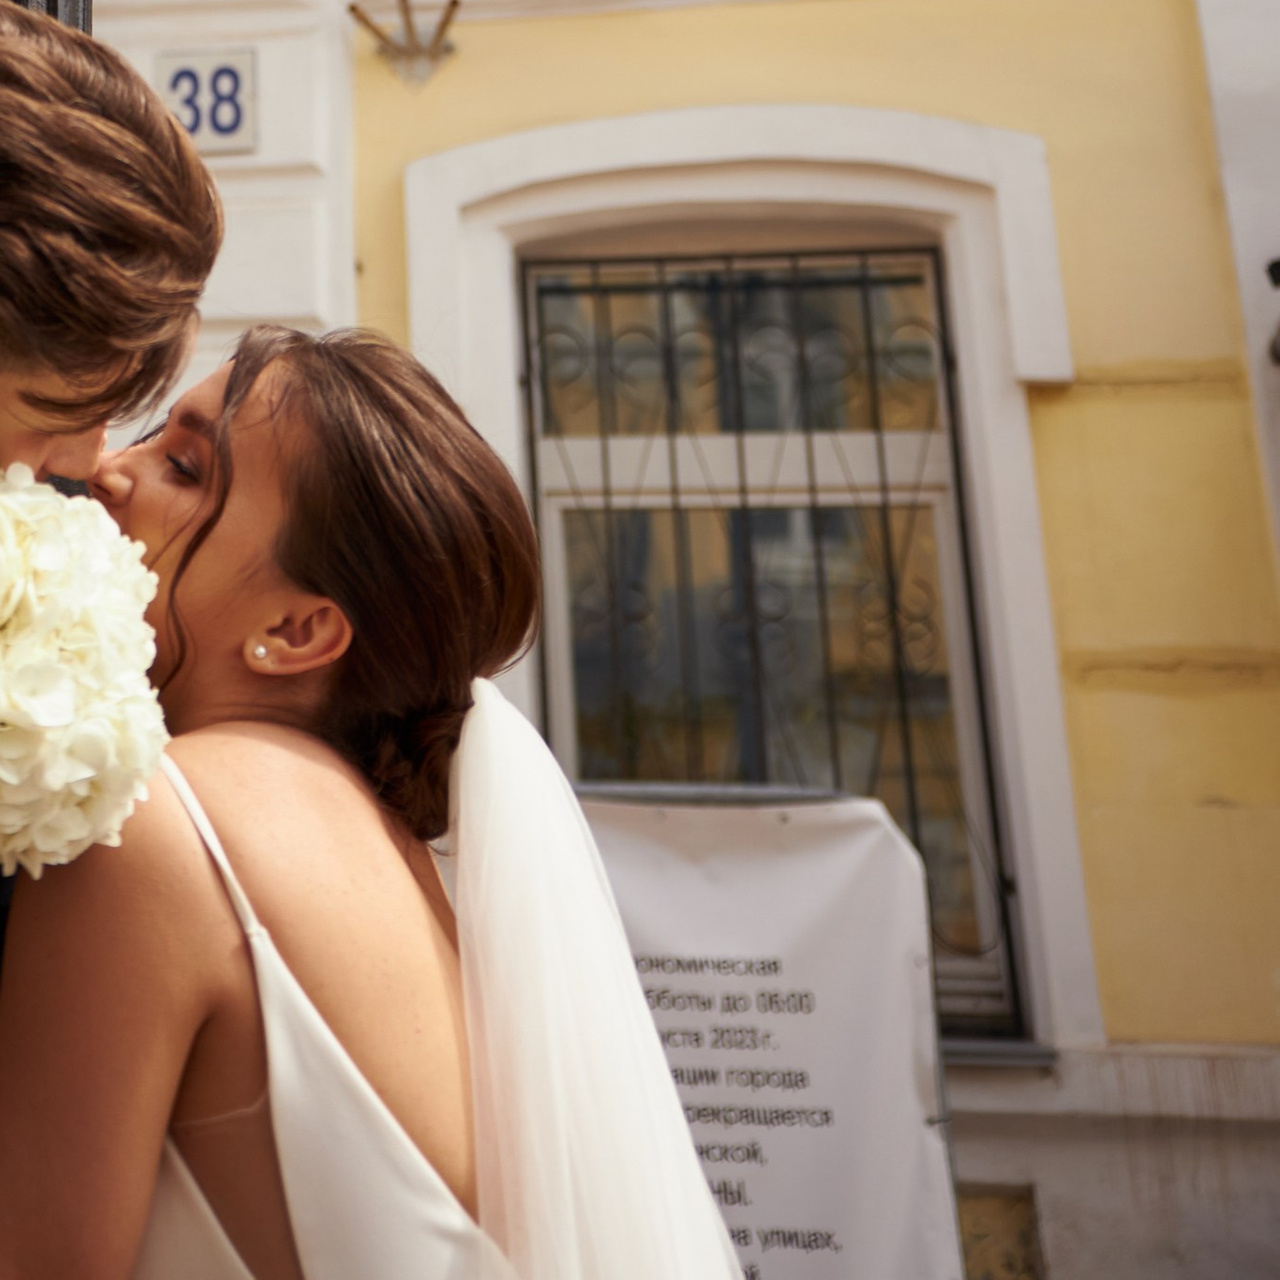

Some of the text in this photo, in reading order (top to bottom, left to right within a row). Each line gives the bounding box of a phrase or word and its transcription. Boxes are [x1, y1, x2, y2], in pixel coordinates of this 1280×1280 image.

[171, 67, 241, 136] 38
[636, 956, 781, 977] ономическая
[644, 989, 714, 1012] бботы
[720, 994, 751, 1017] до
[671, 1067, 811, 1092] ации города
[684, 1105, 835, 1130] рекращается
